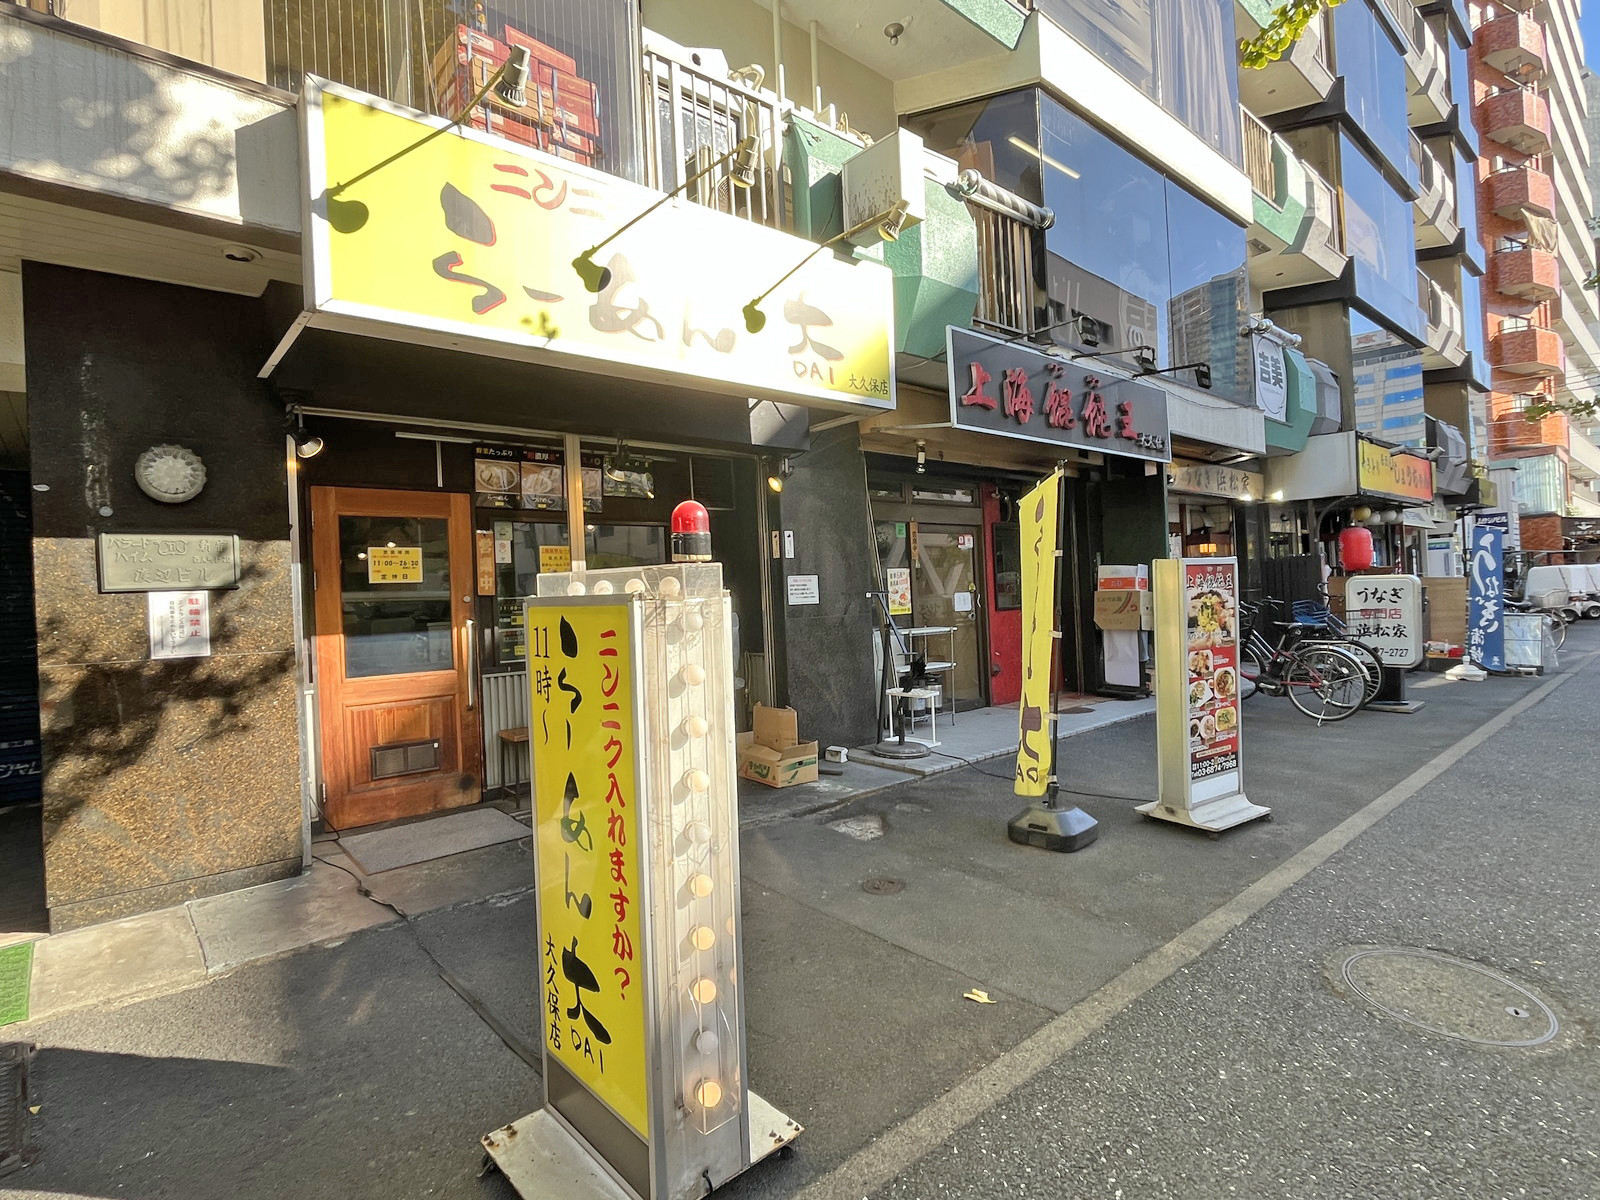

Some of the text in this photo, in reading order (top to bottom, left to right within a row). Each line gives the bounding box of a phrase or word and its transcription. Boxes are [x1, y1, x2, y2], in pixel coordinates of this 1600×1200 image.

[793, 359, 836, 386] DAI
[848, 373, 889, 397] 大久保店
[1357, 587, 1405, 604] うなぎ
[1360, 608, 1402, 620] 専門店
[1356, 623, 1408, 639] 浜松家
[557, 614, 612, 1045] らーめん大
[545, 932, 562, 1052] 大久保店
[570, 1025, 604, 1074] DAI
